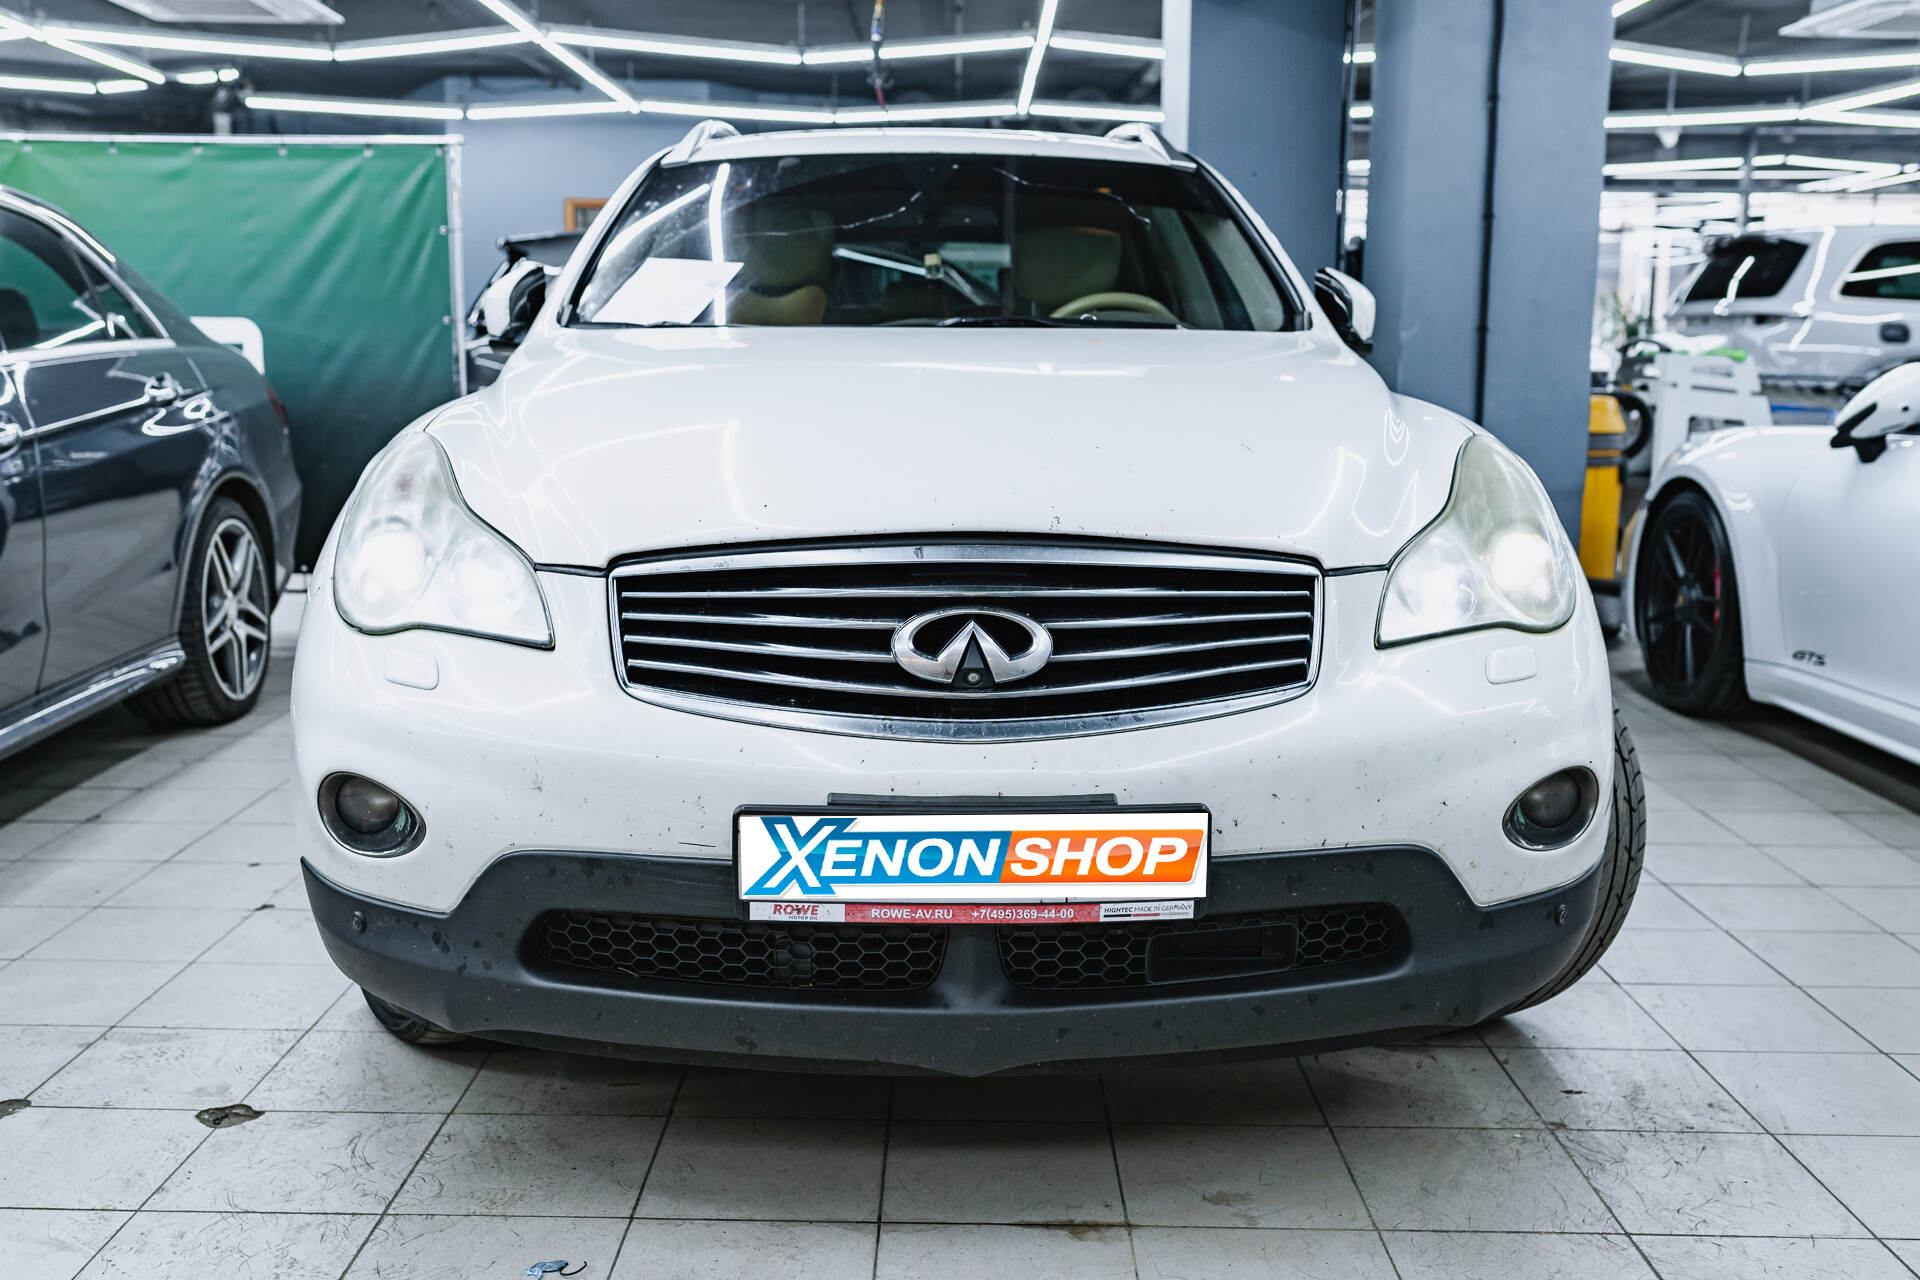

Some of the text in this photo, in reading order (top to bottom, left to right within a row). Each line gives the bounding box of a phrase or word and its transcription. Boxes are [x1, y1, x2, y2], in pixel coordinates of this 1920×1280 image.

[1791, 650, 1826, 667] GTS
[773, 904, 819, 916] ROWE
[1161, 903, 1192, 911] GERMANY
[871, 908, 1074, 920] ROWE-AV.RU +7(495)369-44-00
